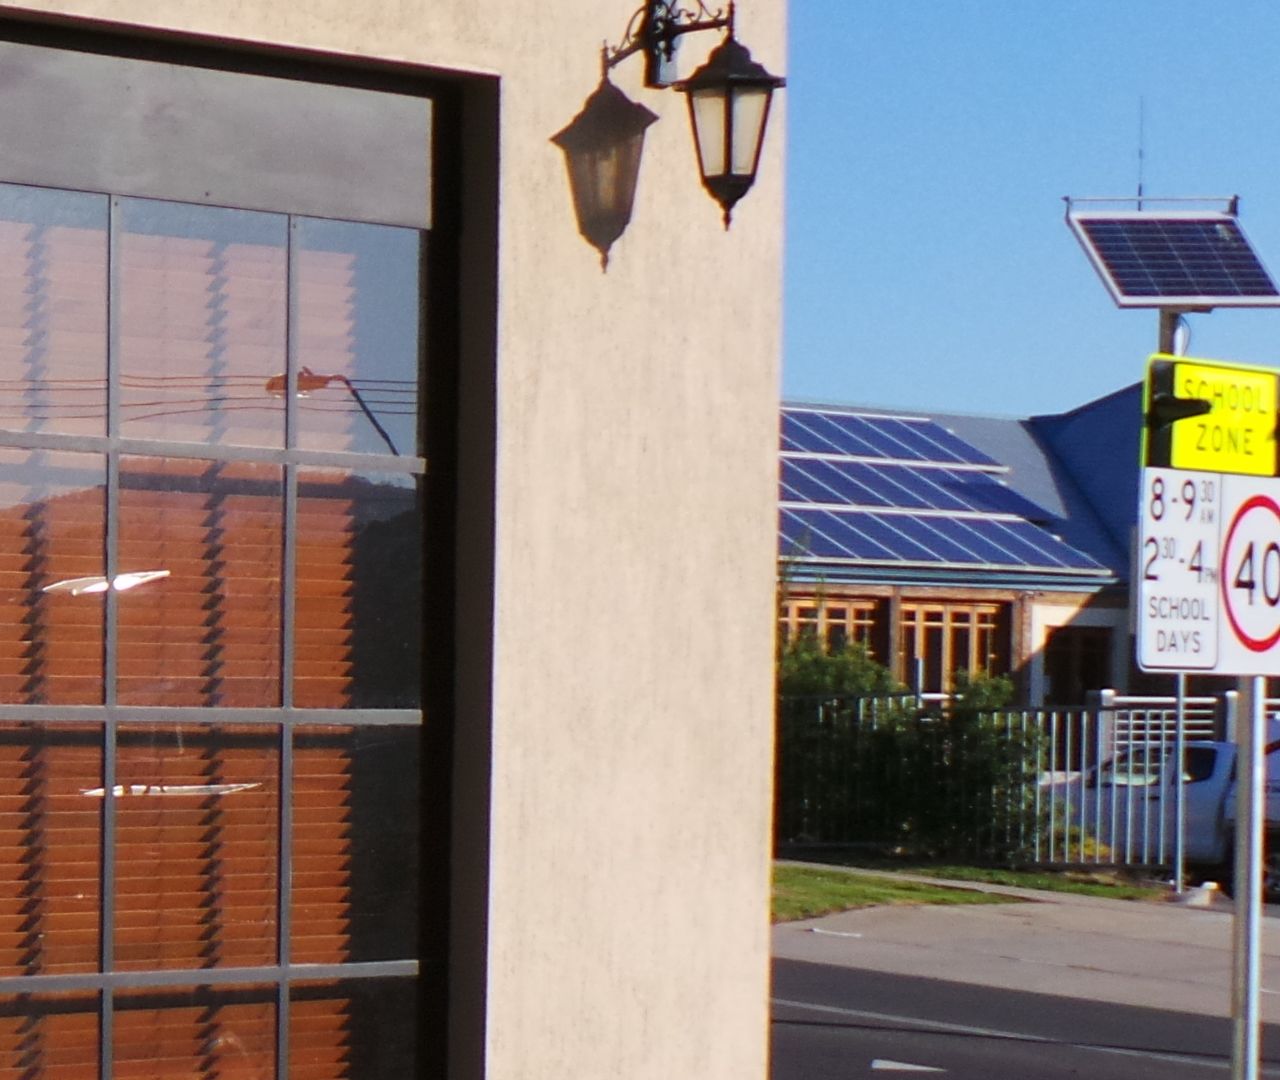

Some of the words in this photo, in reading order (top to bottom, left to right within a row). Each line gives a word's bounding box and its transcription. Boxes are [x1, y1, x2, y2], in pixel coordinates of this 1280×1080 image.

[1184, 378, 1268, 414] SCHOOL
[1195, 423, 1254, 456] ZONE
[1233, 541, 1280, 606] 40
[1148, 596, 1211, 622] SCHOOL
[1156, 630, 1201, 654] DAYS
